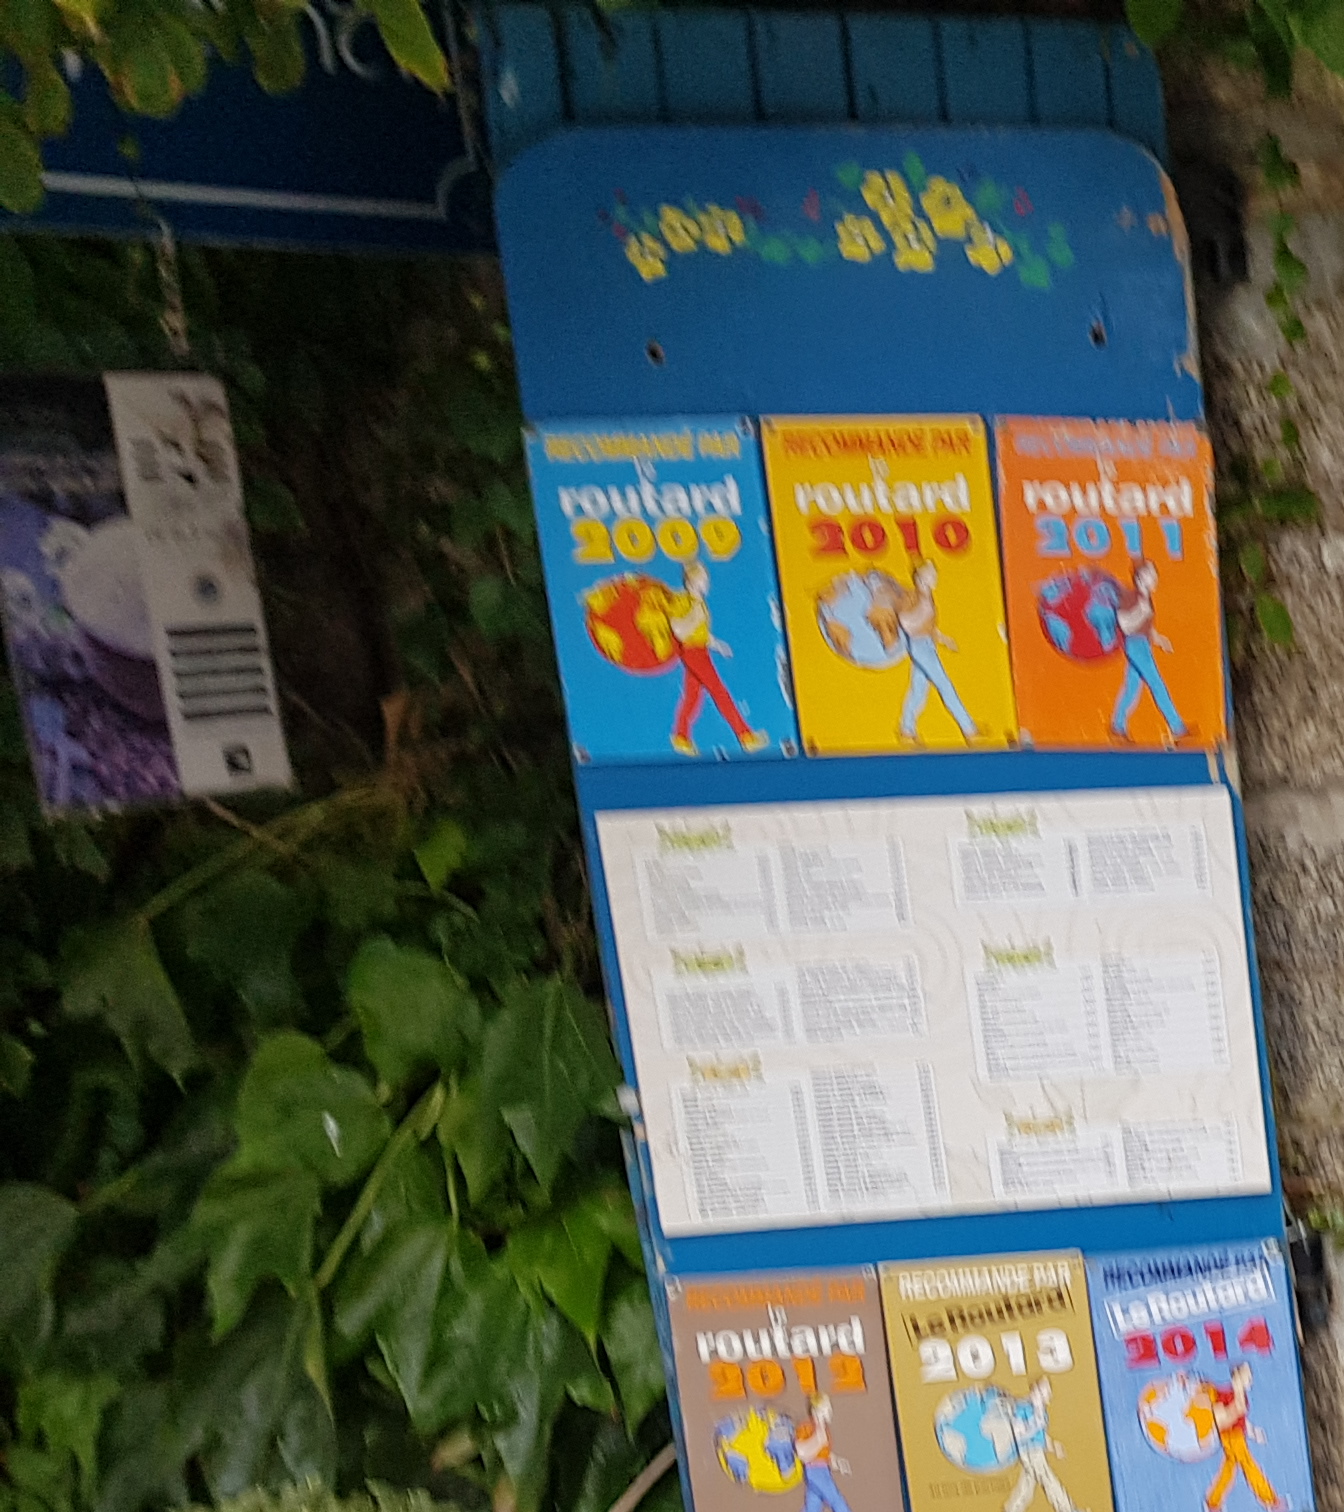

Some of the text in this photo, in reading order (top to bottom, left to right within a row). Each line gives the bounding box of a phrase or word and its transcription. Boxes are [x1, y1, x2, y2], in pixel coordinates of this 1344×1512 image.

[558, 473, 742, 518] routard
[794, 472, 971, 516] routard
[1022, 475, 1194, 519] routard
[571, 515, 742, 565] 2009
[809, 513, 971, 558] 2010
[1034, 513, 1183, 561] 2011
[1033, 1260, 1071, 1289] PAR
[696, 1315, 865, 1364] routard
[919, 1327, 1074, 1383] 2013
[1125, 1314, 1274, 1369] 2014
[709, 1351, 868, 1398] 2012
